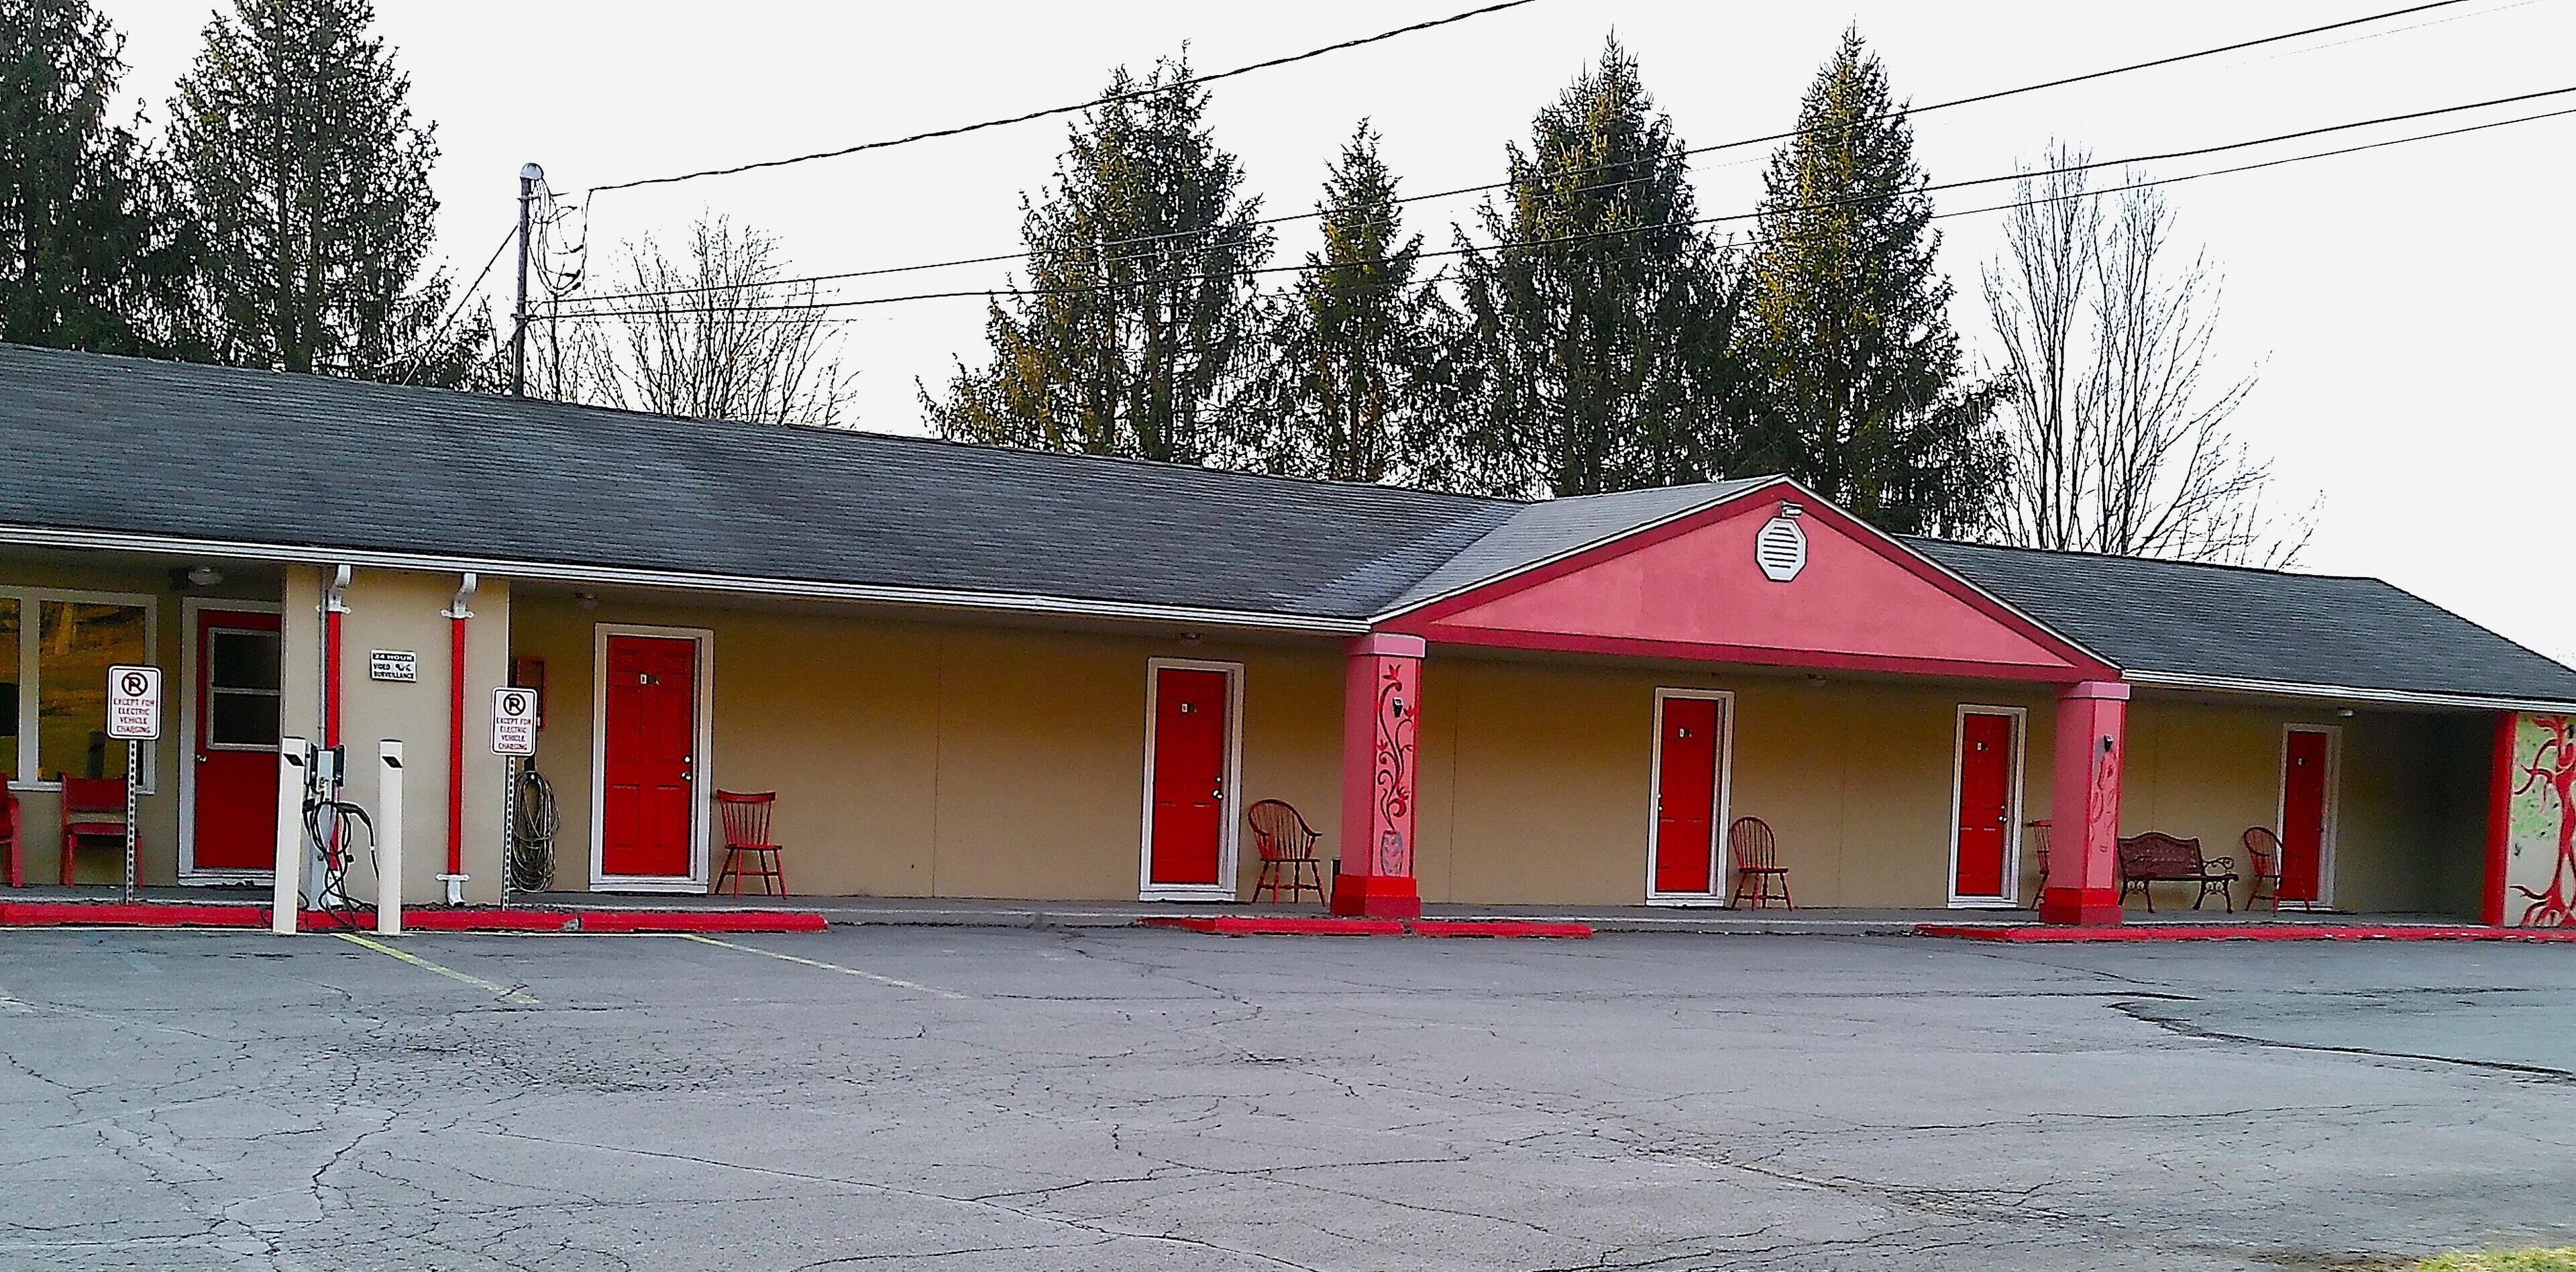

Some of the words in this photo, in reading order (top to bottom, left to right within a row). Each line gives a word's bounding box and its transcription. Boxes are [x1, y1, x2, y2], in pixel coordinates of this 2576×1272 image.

[113, 698, 139, 706] EXCEPT
[118, 707, 150, 715] ELECTRIC
[119, 717, 148, 725] VEHICLE
[116, 725, 151, 733] CHARGING
[498, 743, 527, 751] CHARGING
